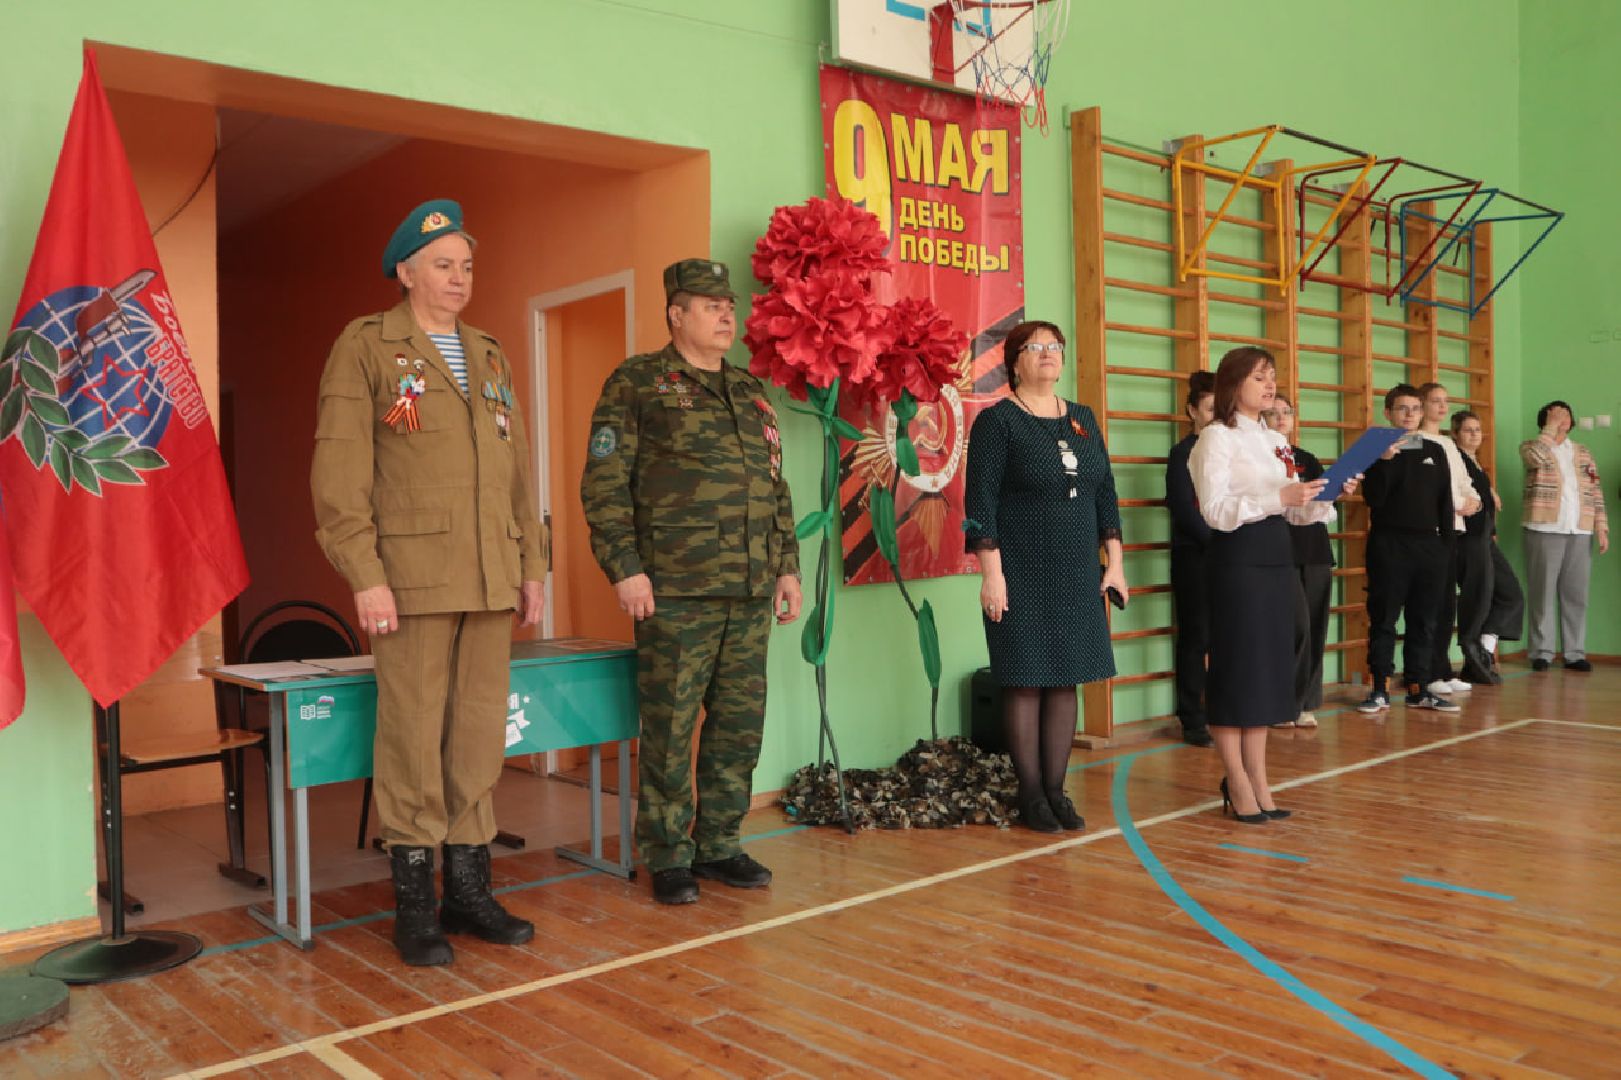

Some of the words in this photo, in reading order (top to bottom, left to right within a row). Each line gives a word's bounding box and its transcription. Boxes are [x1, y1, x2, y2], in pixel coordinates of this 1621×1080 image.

[834, 99, 893, 256] 9
[891, 112, 1009, 194] МАЯ
[900, 197, 965, 232] ДЕНЬ
[900, 233, 1009, 276] ПОБЕДЫ
